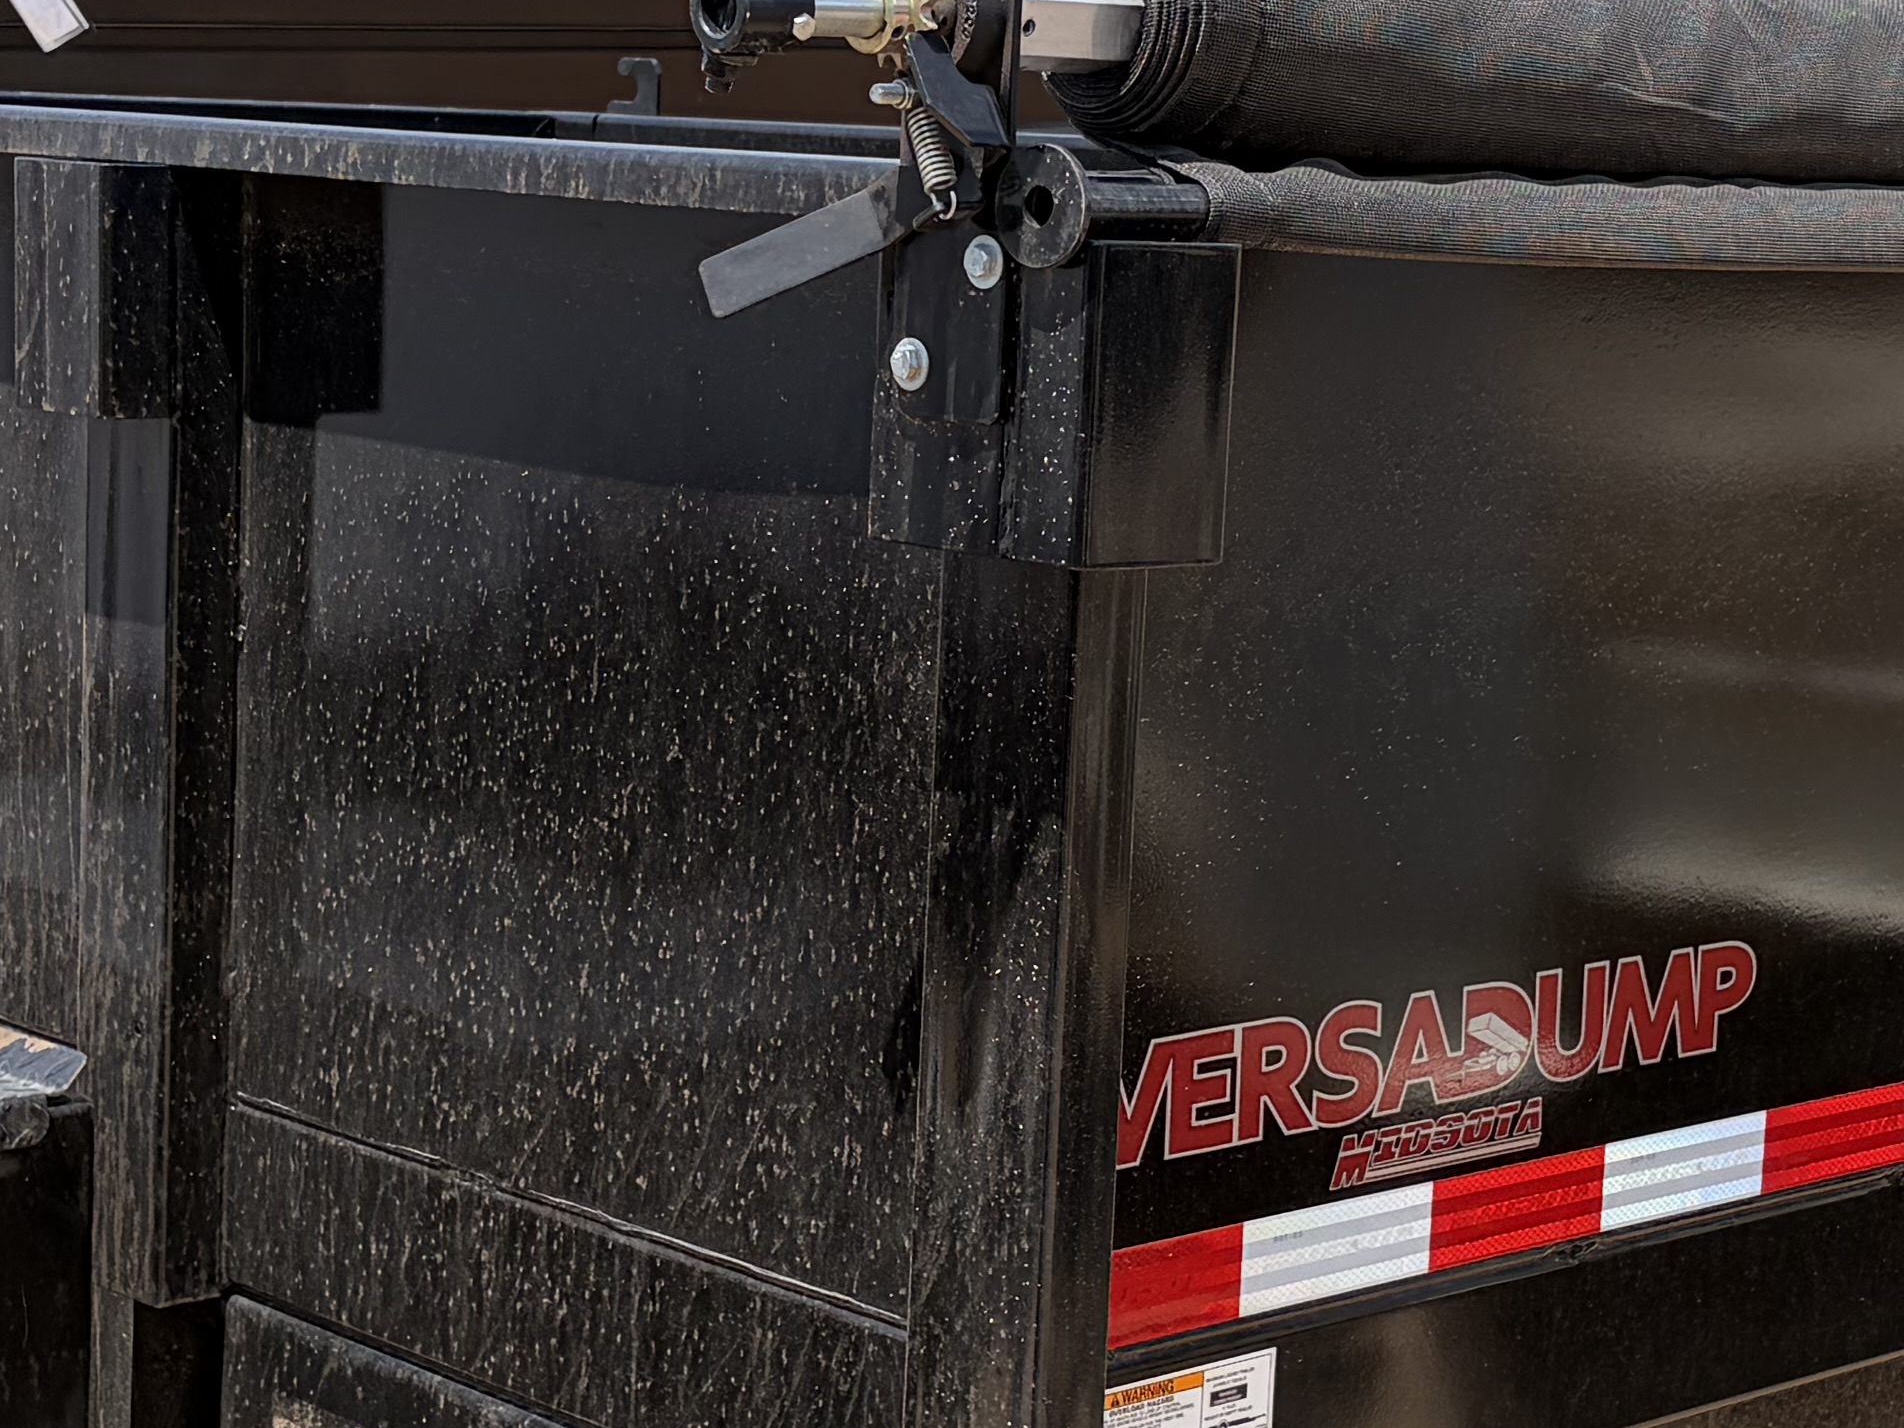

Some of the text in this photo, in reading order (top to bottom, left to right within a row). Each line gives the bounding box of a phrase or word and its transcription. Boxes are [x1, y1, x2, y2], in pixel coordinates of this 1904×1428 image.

[1116, 940, 1757, 1170] VERSADUMP
[1329, 1096, 1543, 1191] MIDSOTA
[1120, 1379, 1175, 1406] WARNING
